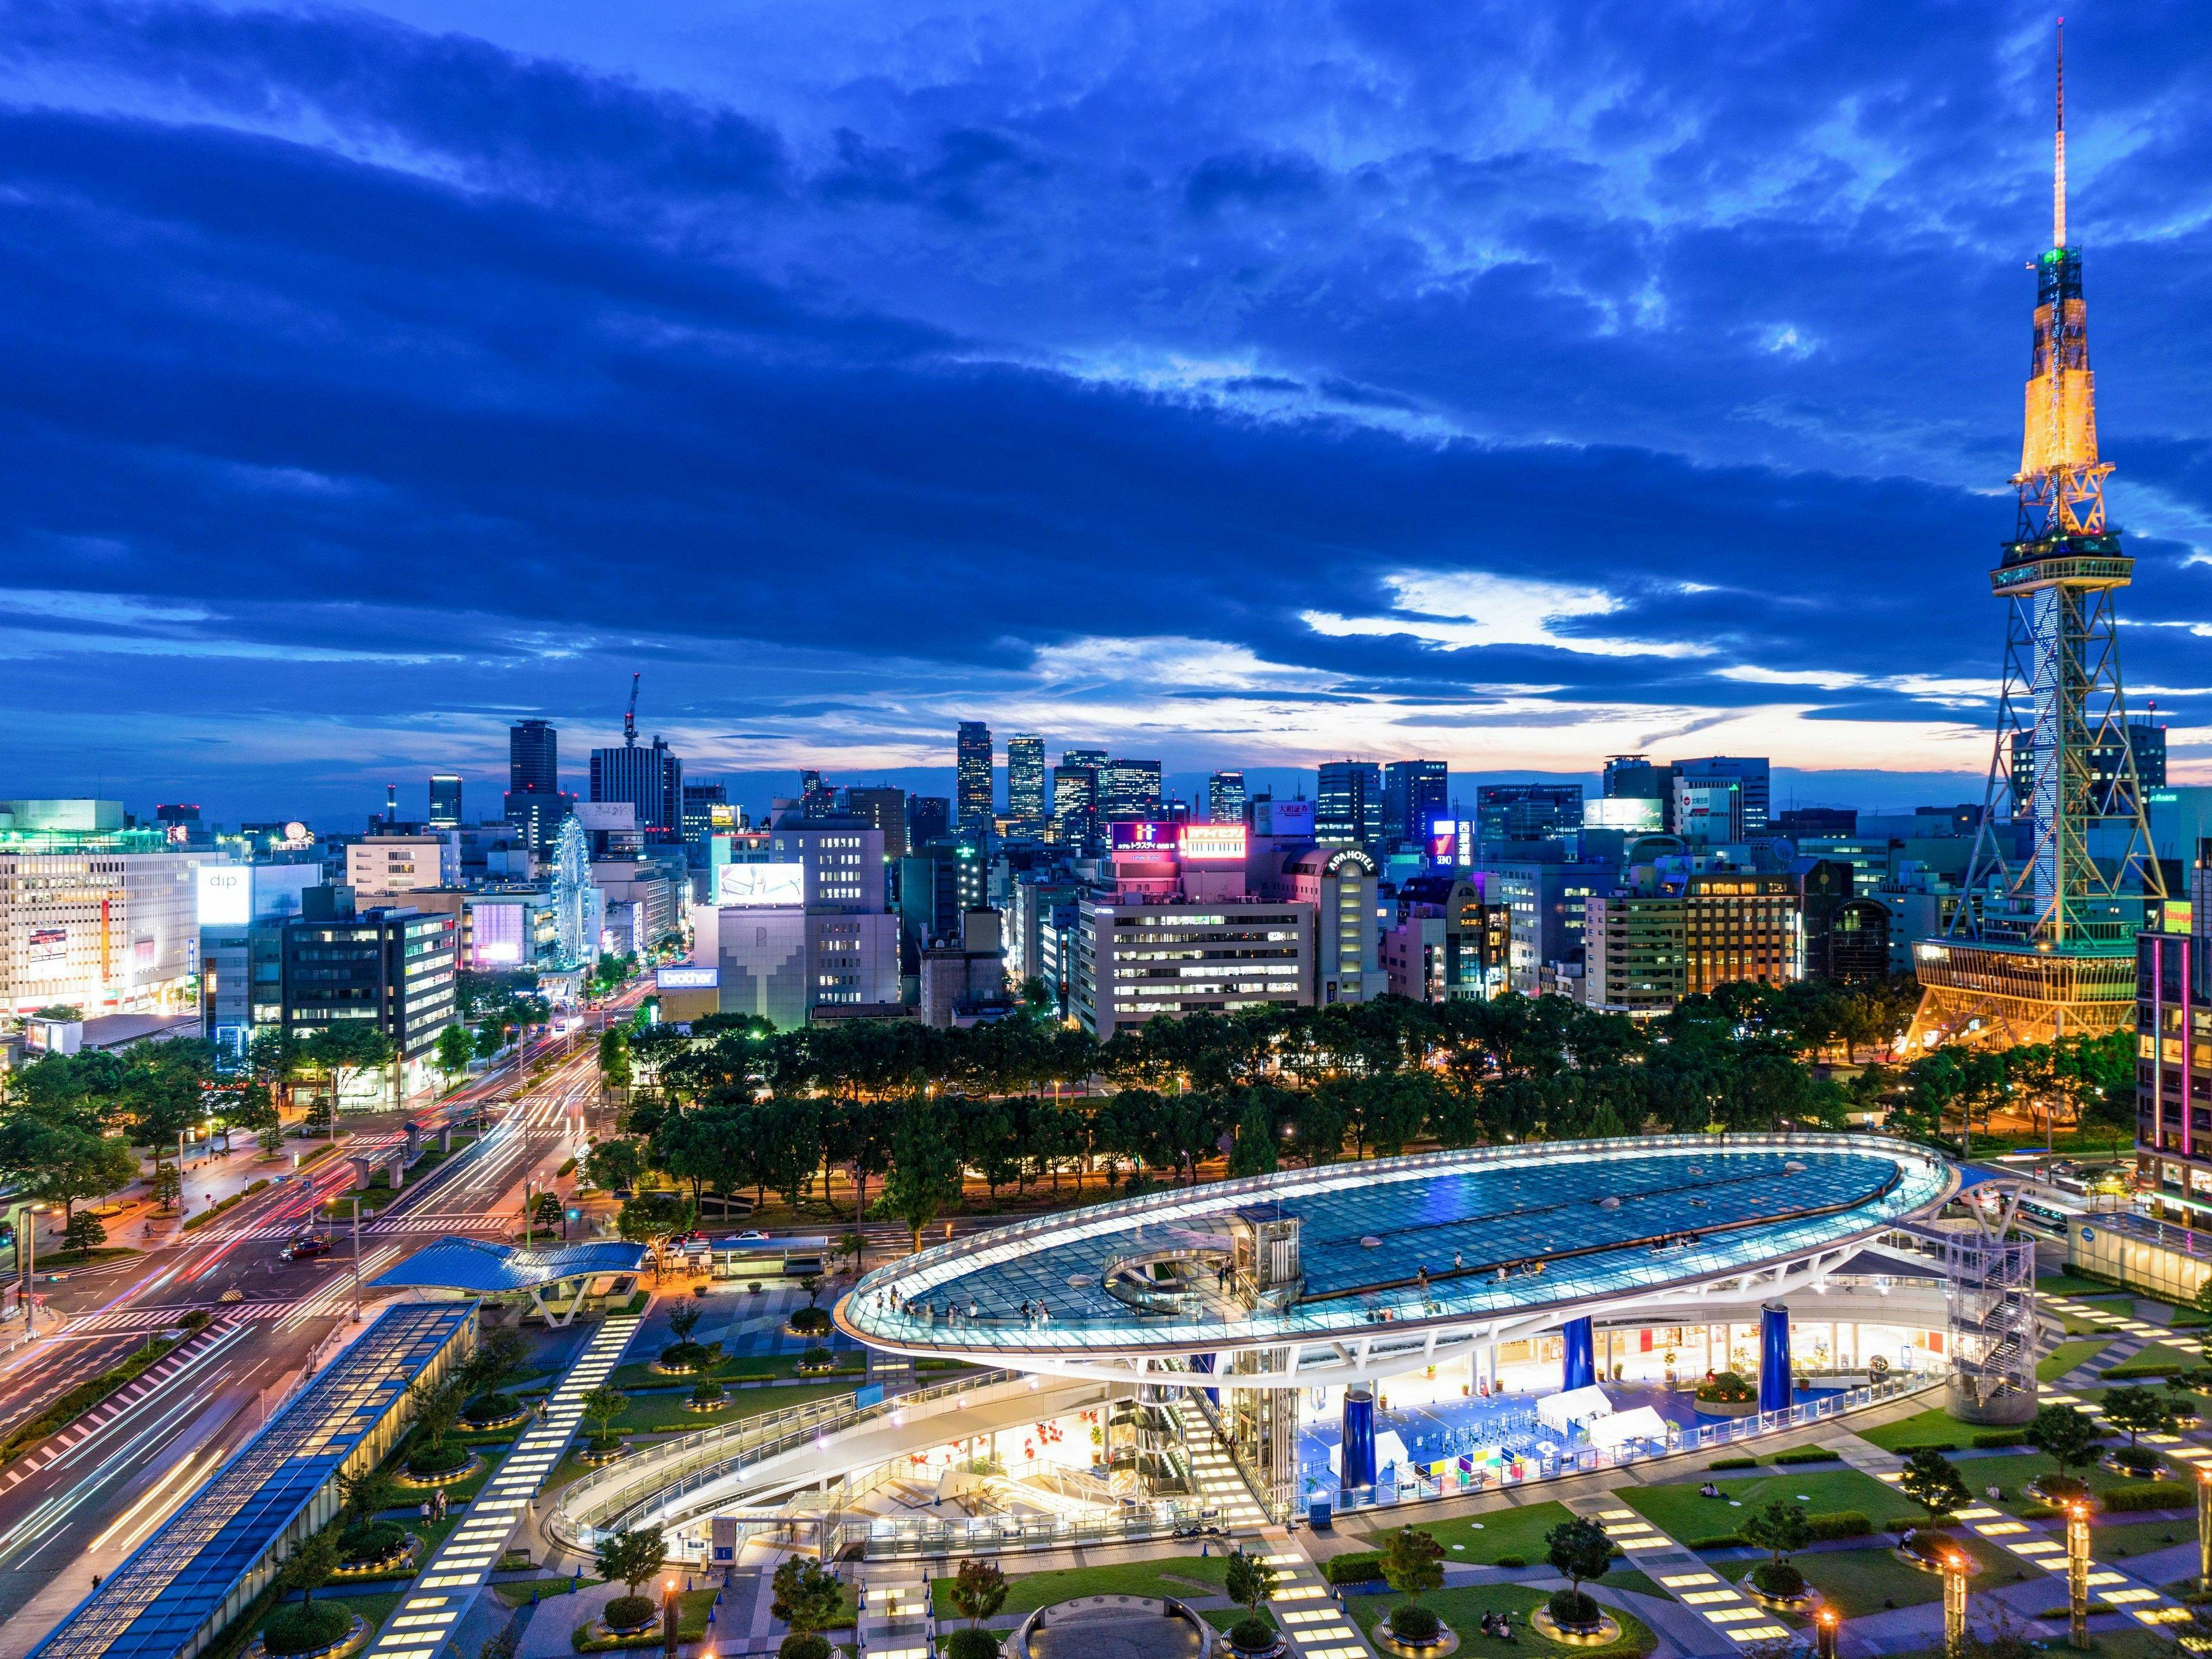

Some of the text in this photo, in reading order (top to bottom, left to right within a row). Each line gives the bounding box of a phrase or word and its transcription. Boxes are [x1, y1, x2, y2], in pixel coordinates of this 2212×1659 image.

[1329, 851, 1374, 871] APA HOTEL
[1437, 855, 1452, 865] SEINO
[210, 874, 237, 889] dip
[663, 972, 713, 984] brother
